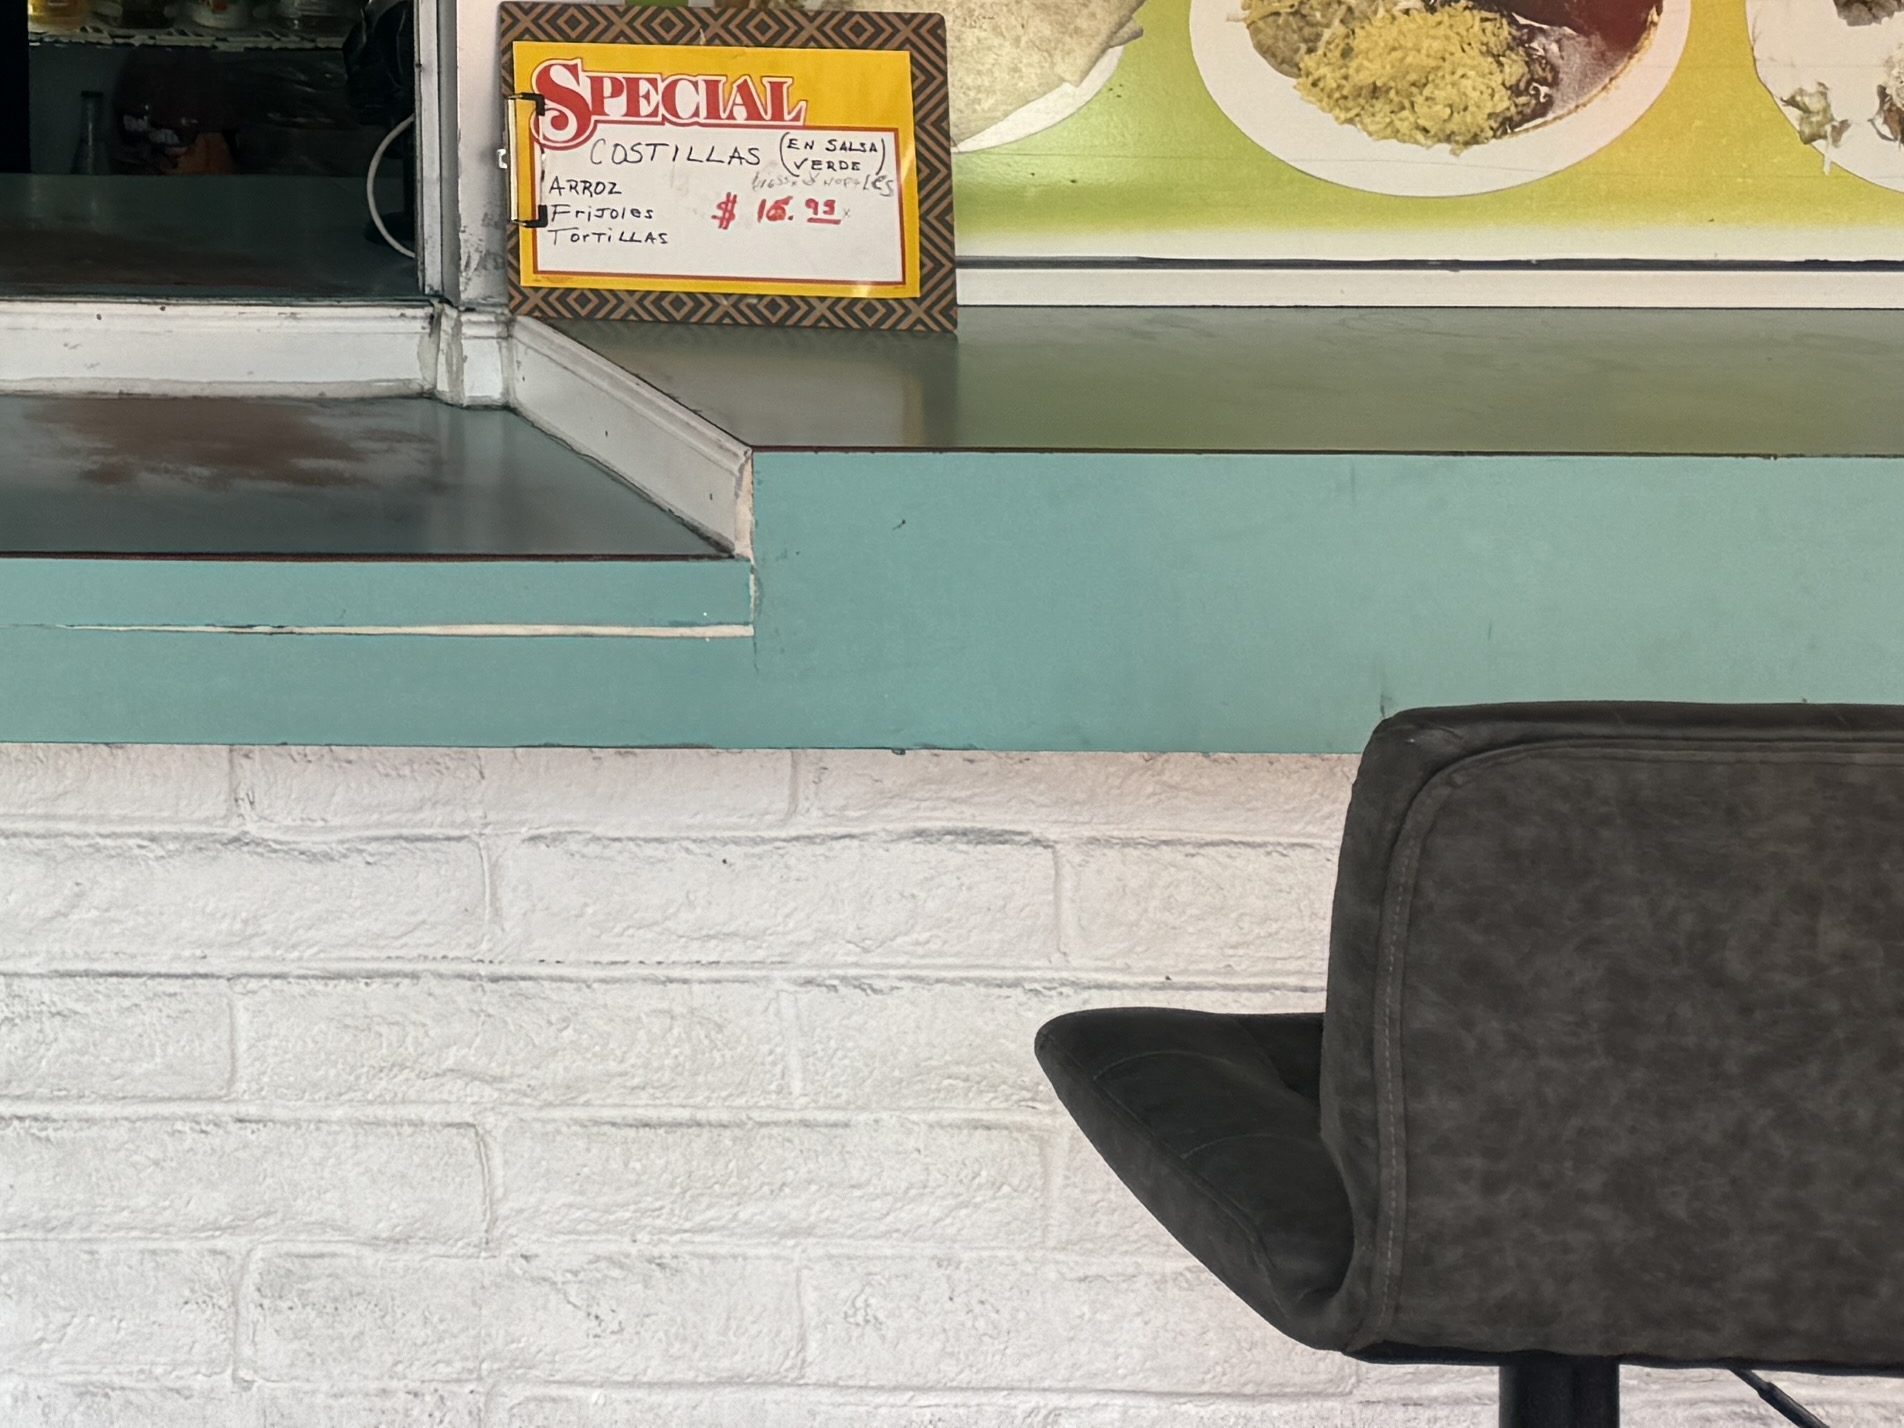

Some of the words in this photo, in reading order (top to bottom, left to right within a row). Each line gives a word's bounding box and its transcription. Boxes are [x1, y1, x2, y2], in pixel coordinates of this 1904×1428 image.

[532, 59, 808, 146] SPECIAL
[590, 139, 761, 165] COSTILLAS
[549, 176, 621, 197] ARROZ
